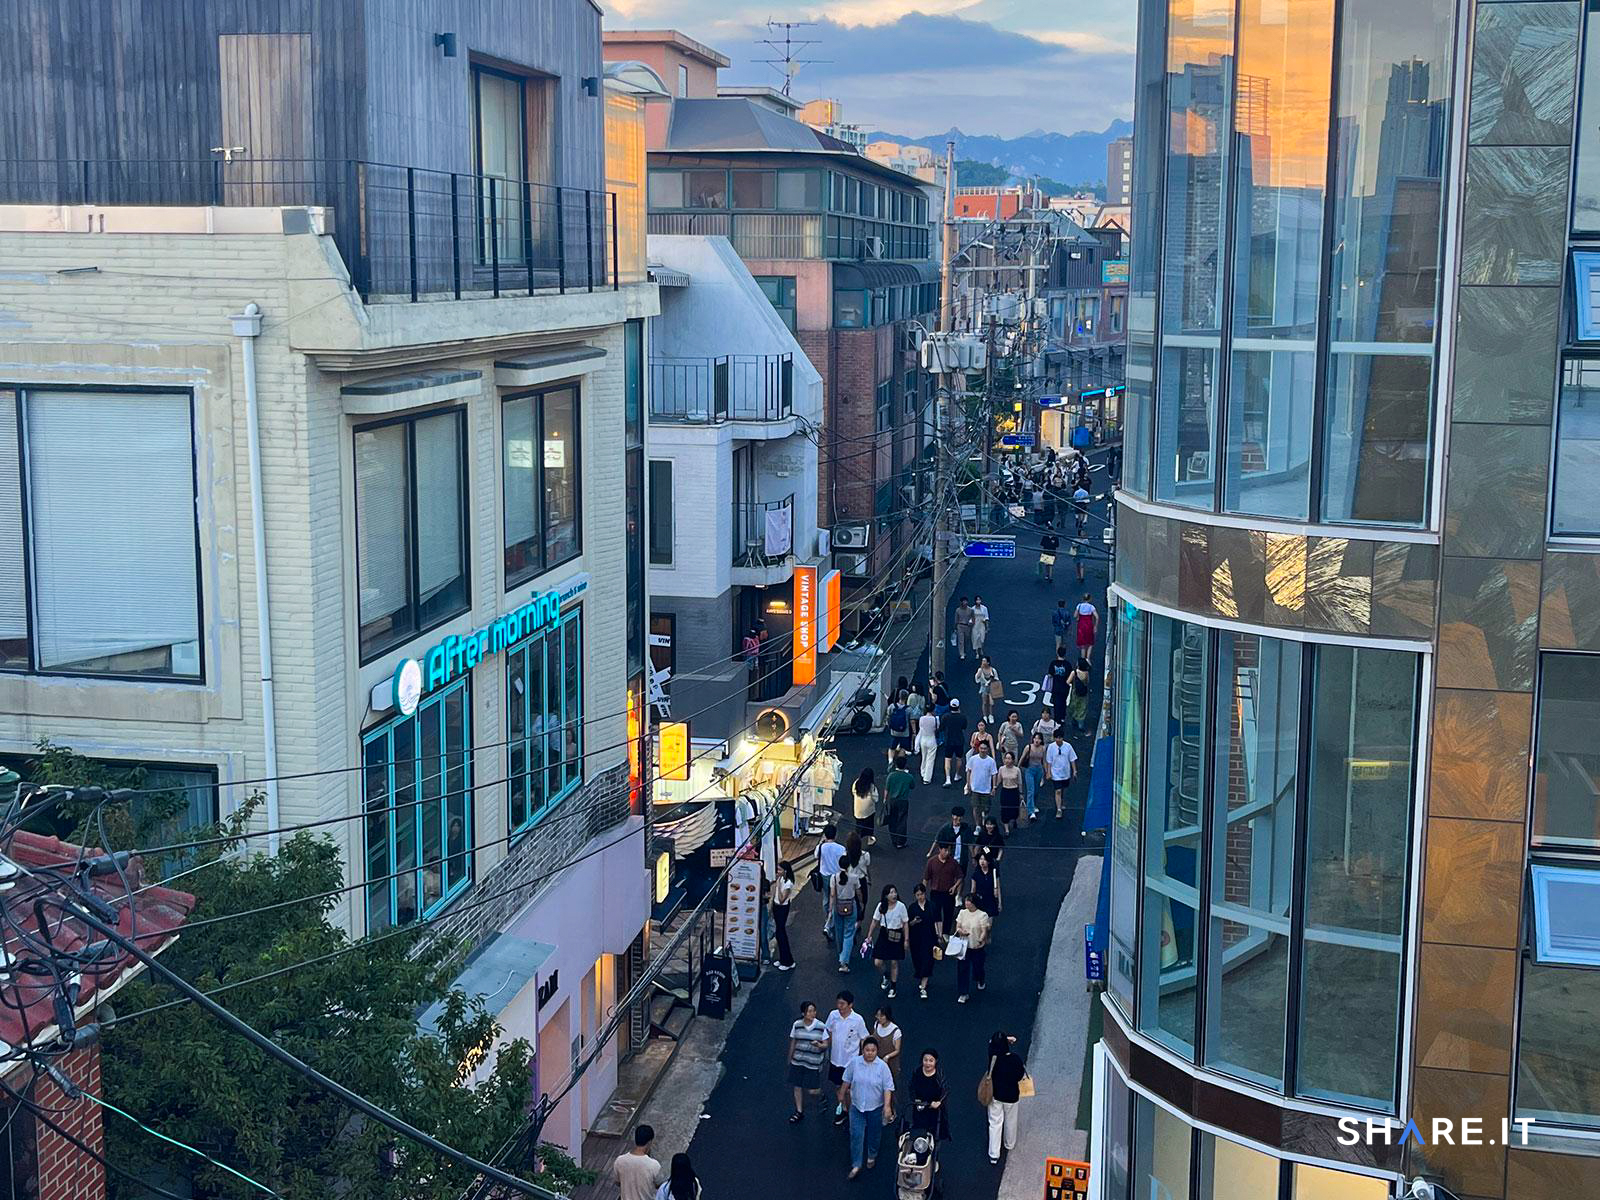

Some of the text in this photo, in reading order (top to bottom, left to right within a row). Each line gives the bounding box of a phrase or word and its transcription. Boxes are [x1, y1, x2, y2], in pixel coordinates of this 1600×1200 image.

[800, 575, 809, 618] VINTAGE
[425, 590, 560, 691] After morning
[658, 637, 671, 645] VIN
[800, 621, 809, 648] SHOP
